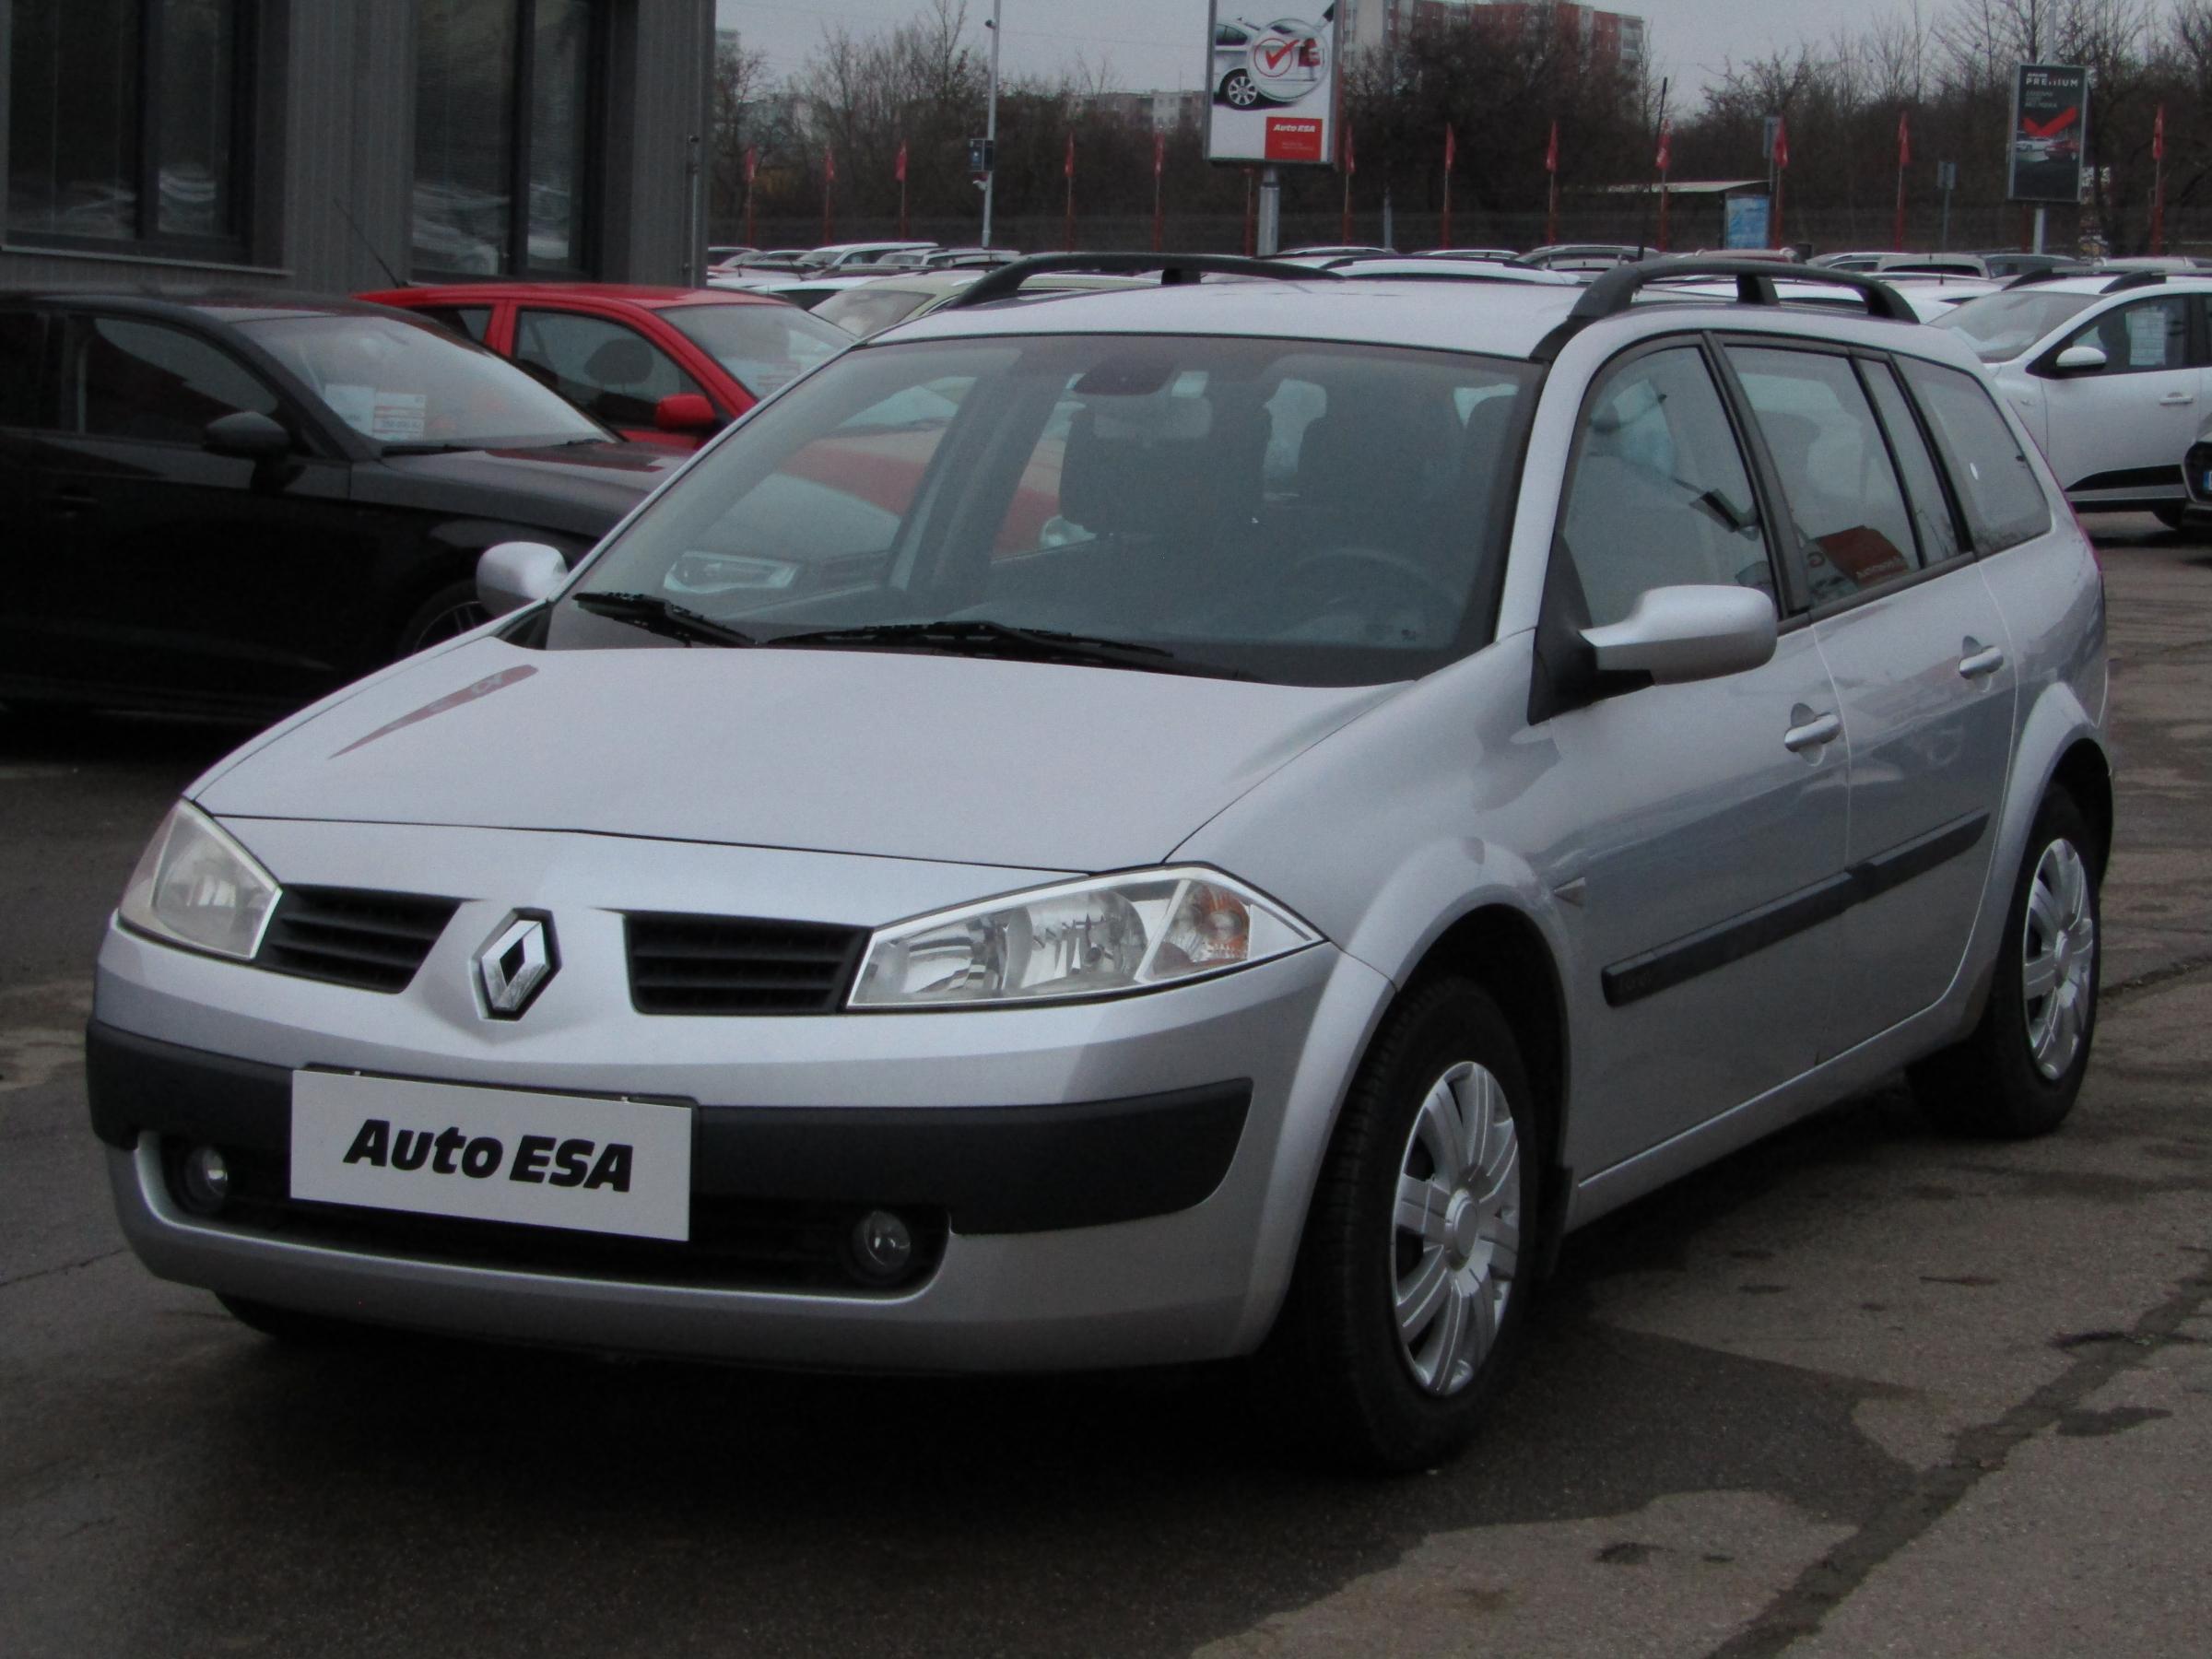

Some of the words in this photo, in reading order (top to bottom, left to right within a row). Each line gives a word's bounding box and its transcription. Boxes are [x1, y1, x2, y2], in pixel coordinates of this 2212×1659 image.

[1273, 124, 1297, 132] Auto
[342, 1118, 504, 1179] Auto
[509, 1135, 634, 1192] ESA
